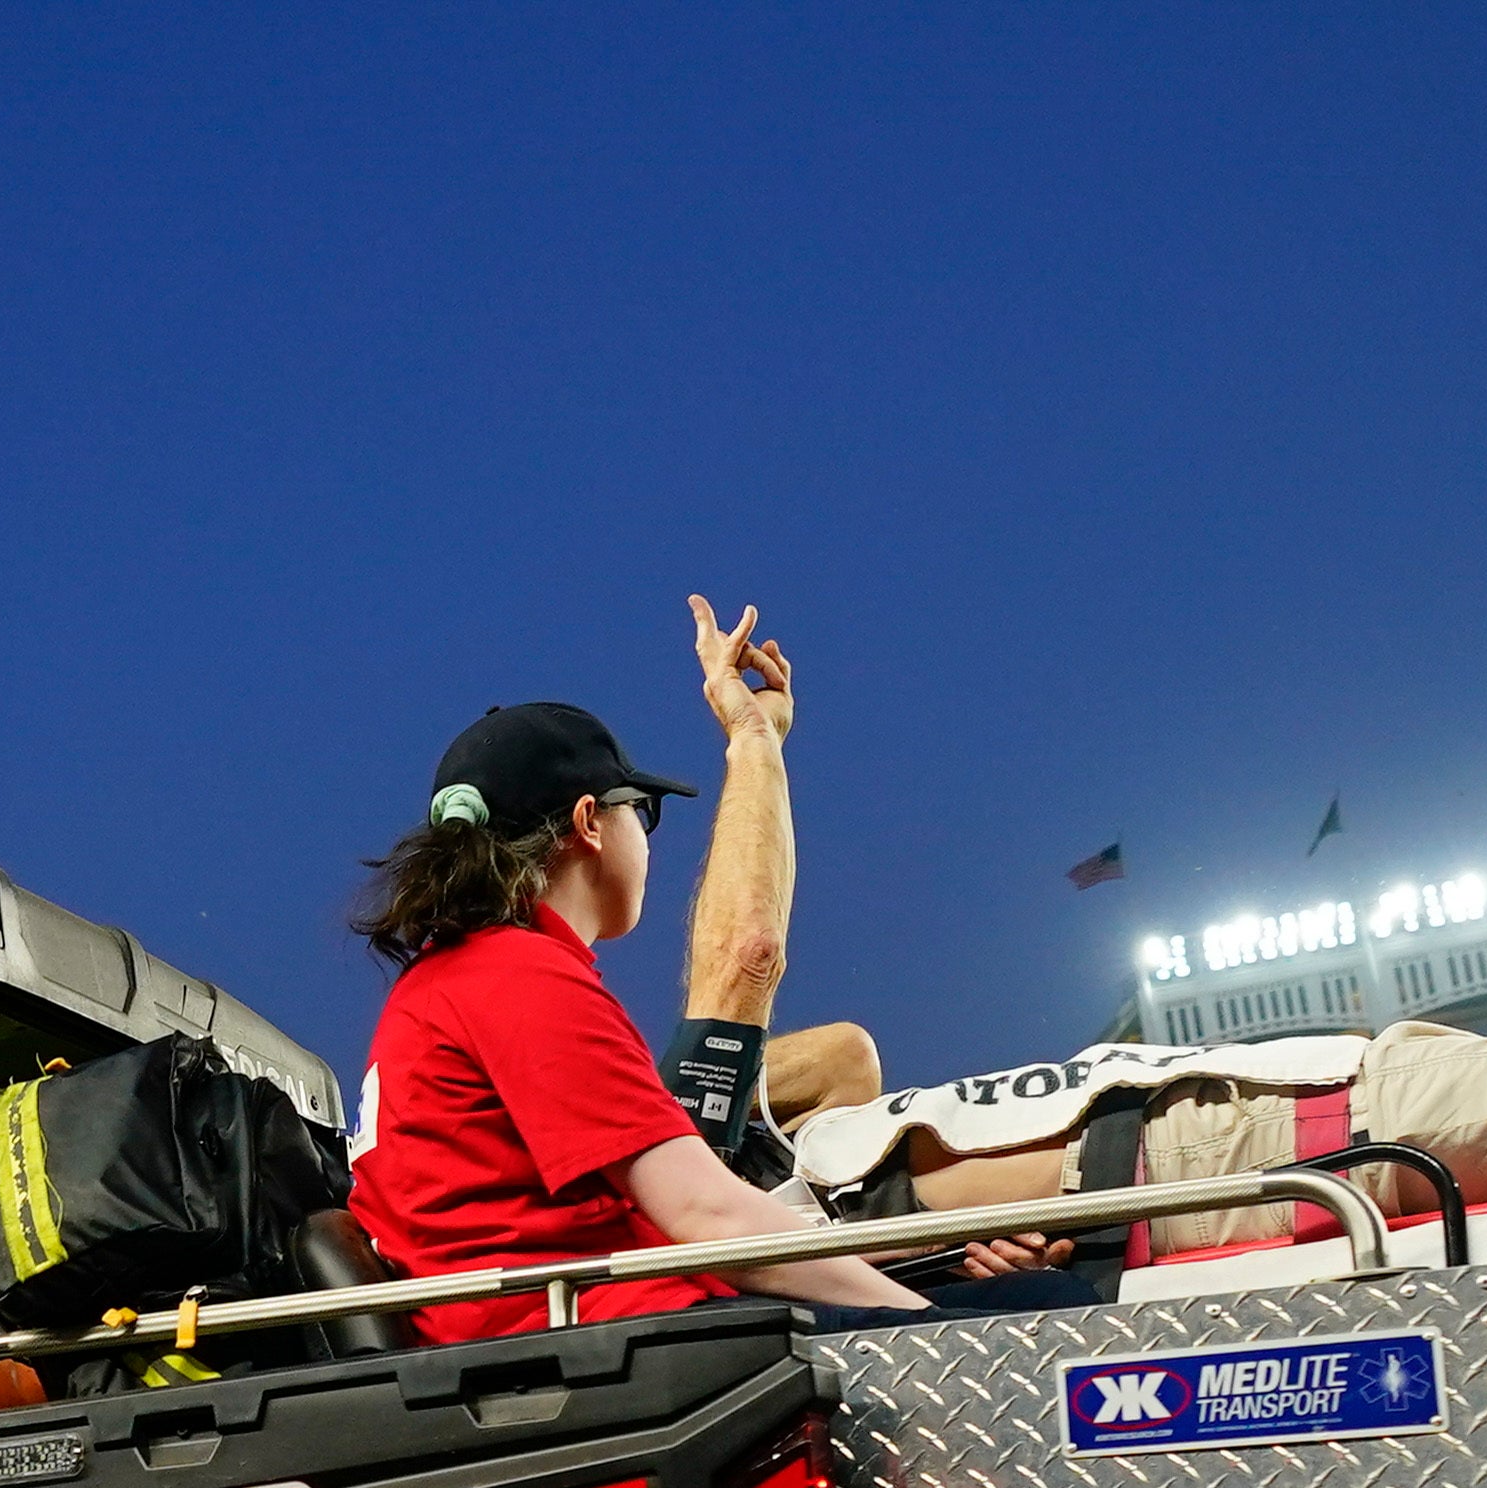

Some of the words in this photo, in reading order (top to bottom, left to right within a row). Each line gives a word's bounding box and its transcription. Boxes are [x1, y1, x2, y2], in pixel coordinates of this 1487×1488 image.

[198, 1033, 312, 1118] EDICAL
[1197, 1352, 1353, 1398] MEDLITE
[1197, 1388, 1347, 1424] TRANSPORT
